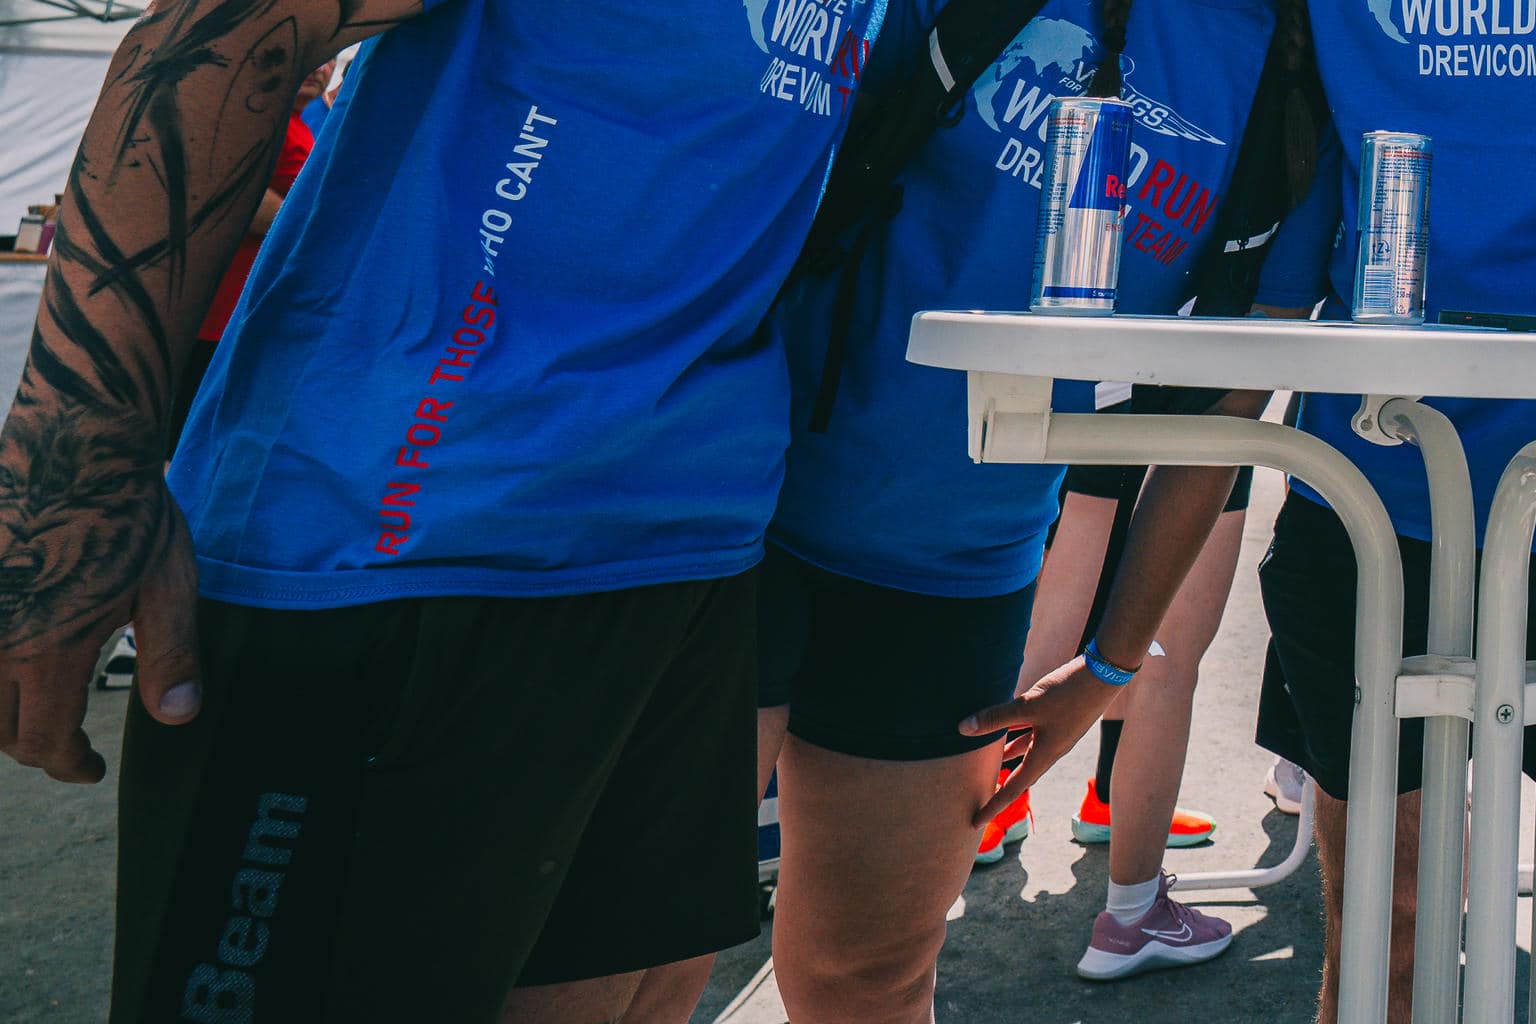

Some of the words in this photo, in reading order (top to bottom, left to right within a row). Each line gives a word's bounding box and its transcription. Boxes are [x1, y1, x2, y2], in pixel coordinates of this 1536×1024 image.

[1059, 76, 1083, 92] FOR
[495, 105, 558, 201] CAN'T
[1105, 175, 1127, 199] Re
[1138, 159, 1220, 234] RUN
[1126, 212, 1189, 266] TEAM
[429, 281, 498, 385] THOSE
[396, 397, 454, 469] FOR
[375, 482, 421, 555] RUN
